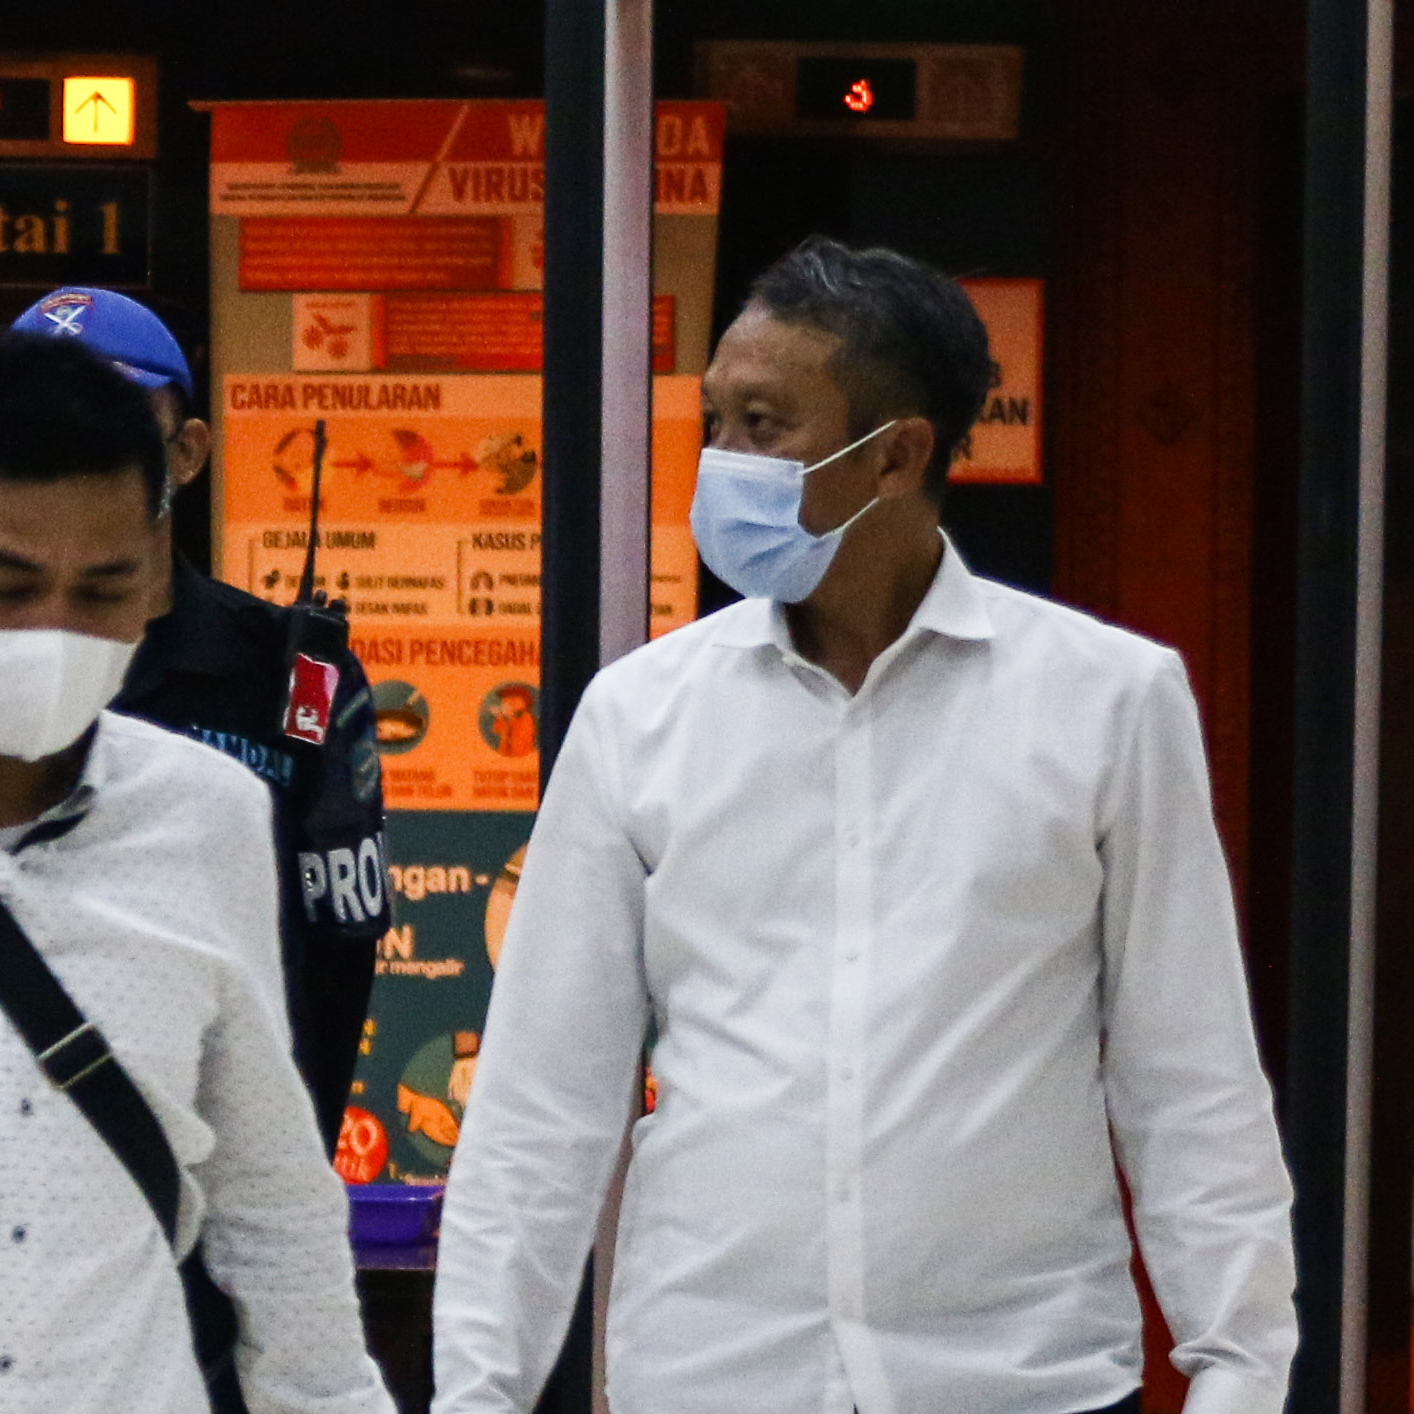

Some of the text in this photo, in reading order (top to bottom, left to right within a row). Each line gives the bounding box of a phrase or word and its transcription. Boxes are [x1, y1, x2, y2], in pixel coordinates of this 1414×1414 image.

[844, 79, 873, 111] 3
[100, 201, 121, 254] 1
[230, 383, 441, 411] CARA PENULARAN
[409, 638, 541, 667] PENCEGAH
[298, 832, 385, 923] PRO
